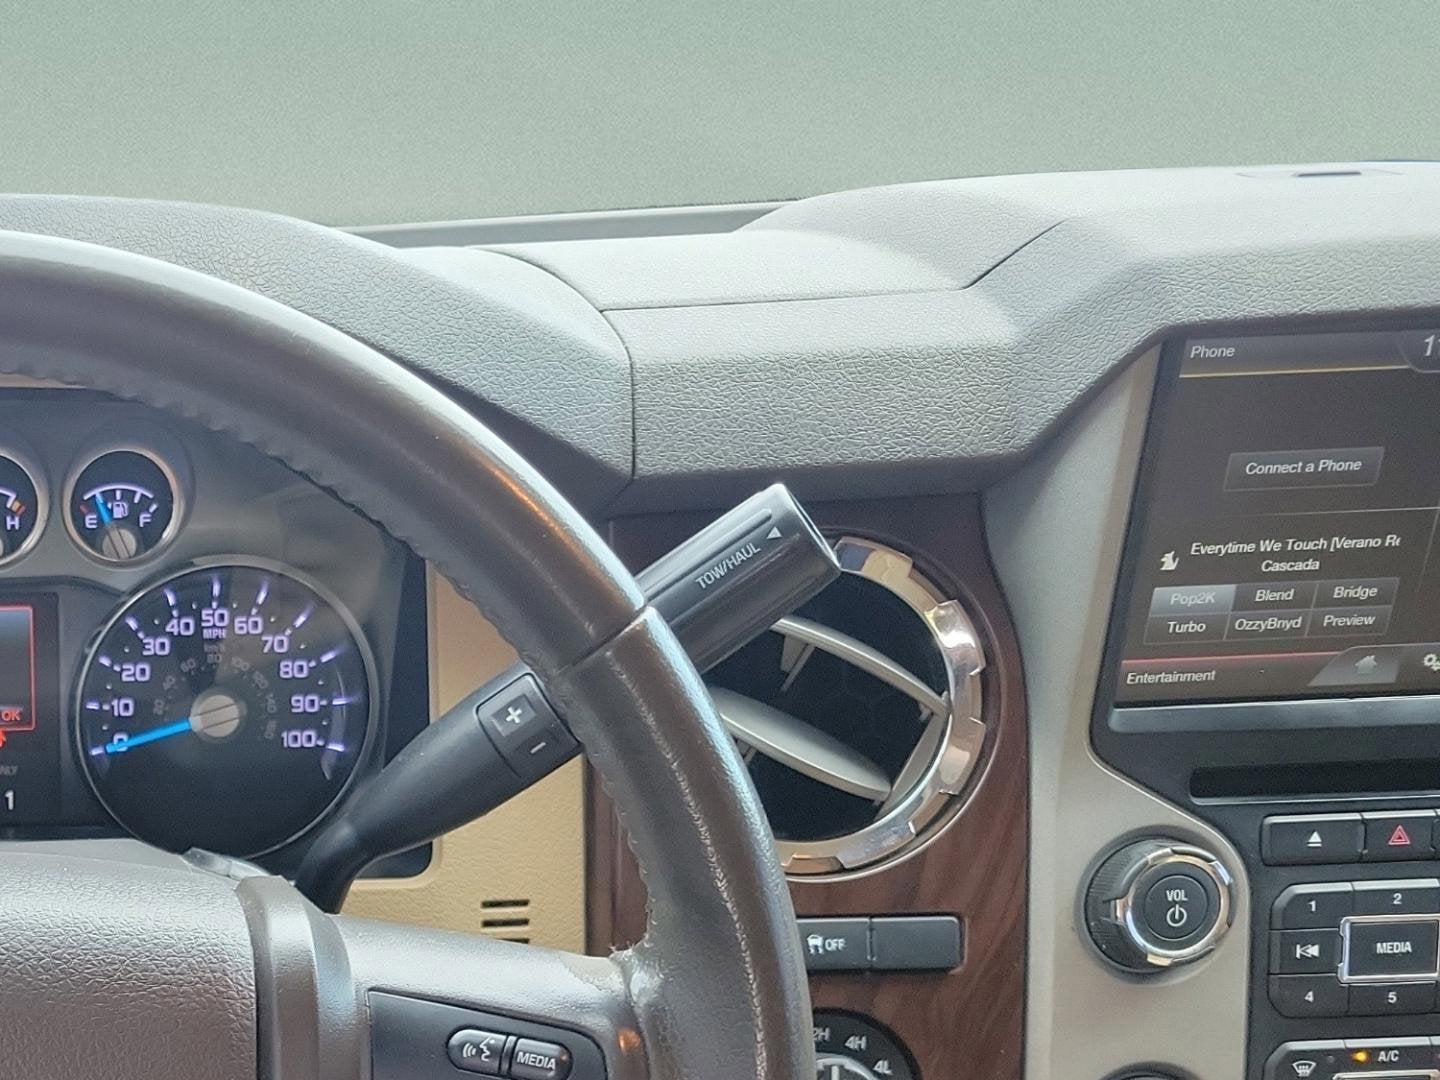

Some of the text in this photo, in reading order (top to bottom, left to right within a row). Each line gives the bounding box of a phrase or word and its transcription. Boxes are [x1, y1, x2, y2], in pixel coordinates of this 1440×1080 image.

[1190, 344, 1235, 359] Phone
[1423, 334, 1440, 357] 1
[1245, 459, 1362, 476] Connect a Phone
[6, 516, 19, 531] H
[85, 515, 97, 529] E
[139, 513, 152, 528] F
[1190, 541, 1256, 556] Everytime
[1260, 539, 1282, 551] We
[1286, 538, 1327, 551] Touch
[1330, 536, 1382, 552] [Verano
[695, 542, 761, 589] TOW/HAUL
[1261, 558, 1320, 573] Cascada
[1170, 591, 1217, 607] Pop2K
[1255, 588, 1295, 601] Blend
[1333, 585, 1378, 600] Bridge
[201, 609, 229, 627] 50
[234, 616, 263, 635] 60
[1235, 616, 1303, 632] OzzyBnyd
[1323, 613, 1377, 628] Preview
[165, 617, 195, 637] 40
[203, 628, 226, 639] MPH
[1167, 620, 1207, 634] Turbo
[142, 637, 170, 656] 30
[261, 635, 289, 653] 70
[121, 663, 150, 682] 20
[279, 660, 308, 679] 80
[1126, 671, 1216, 685] Entertainment
[111, 698, 135, 716] 10
[291, 695, 319, 713] 90
[0, 709, 21, 722] OK
[281, 730, 317, 749] 100
[5, 790, 15, 810] 1
[1166, 889, 1188, 901] VOL
[1392, 893, 1402, 905] 2
[1308, 901, 1317, 912] 1
[825, 938, 846, 951] OFF
[1376, 941, 1413, 955] MEDIA
[1304, 991, 1314, 1003] 4
[1387, 992, 1397, 1004] 5
[844, 1035, 867, 1051] 4H
[516, 1051, 557, 1070] MEDIA
[1378, 1050, 1400, 1062] A/C
[873, 1060, 893, 1075] 4L
